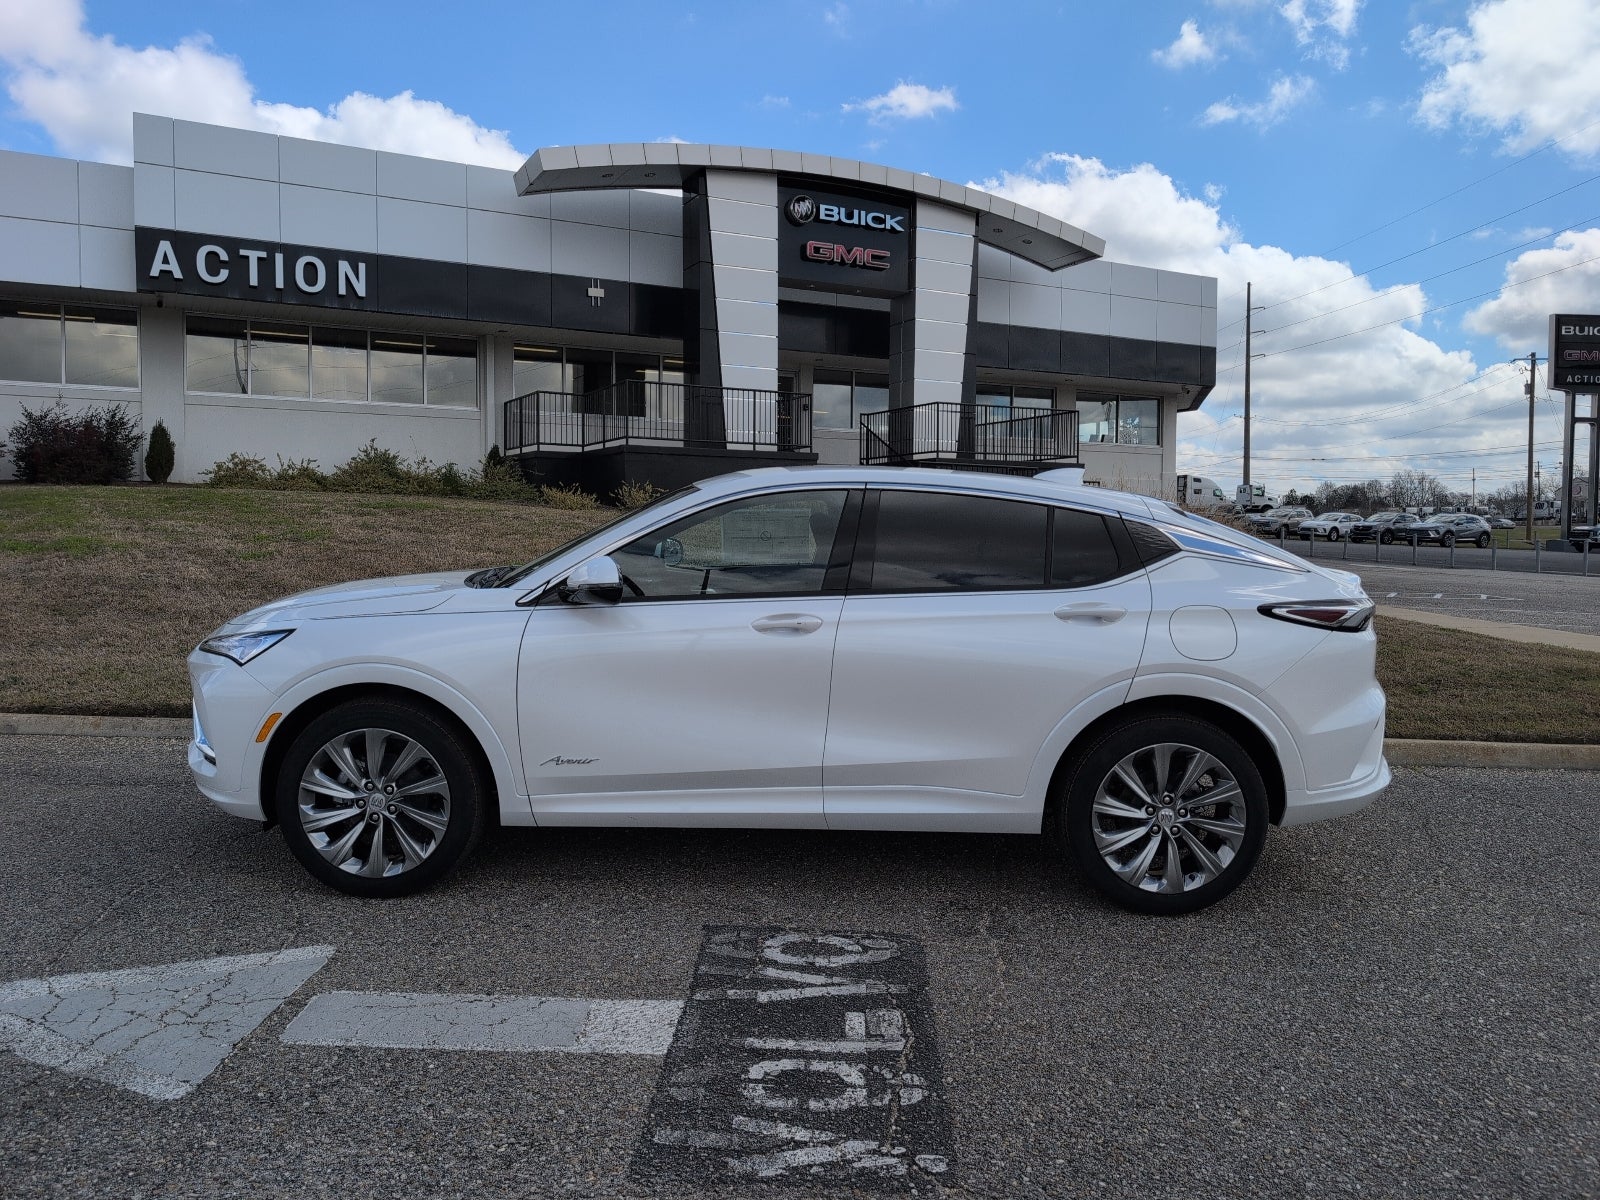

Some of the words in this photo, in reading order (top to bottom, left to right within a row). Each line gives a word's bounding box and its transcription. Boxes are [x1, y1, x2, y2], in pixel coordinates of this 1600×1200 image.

[819, 204, 905, 232] BUICK
[806, 240, 891, 269] GMC
[149, 240, 367, 298] ACTION
[1563, 349, 1600, 361] GM
[539, 755, 600, 766] Avenir
